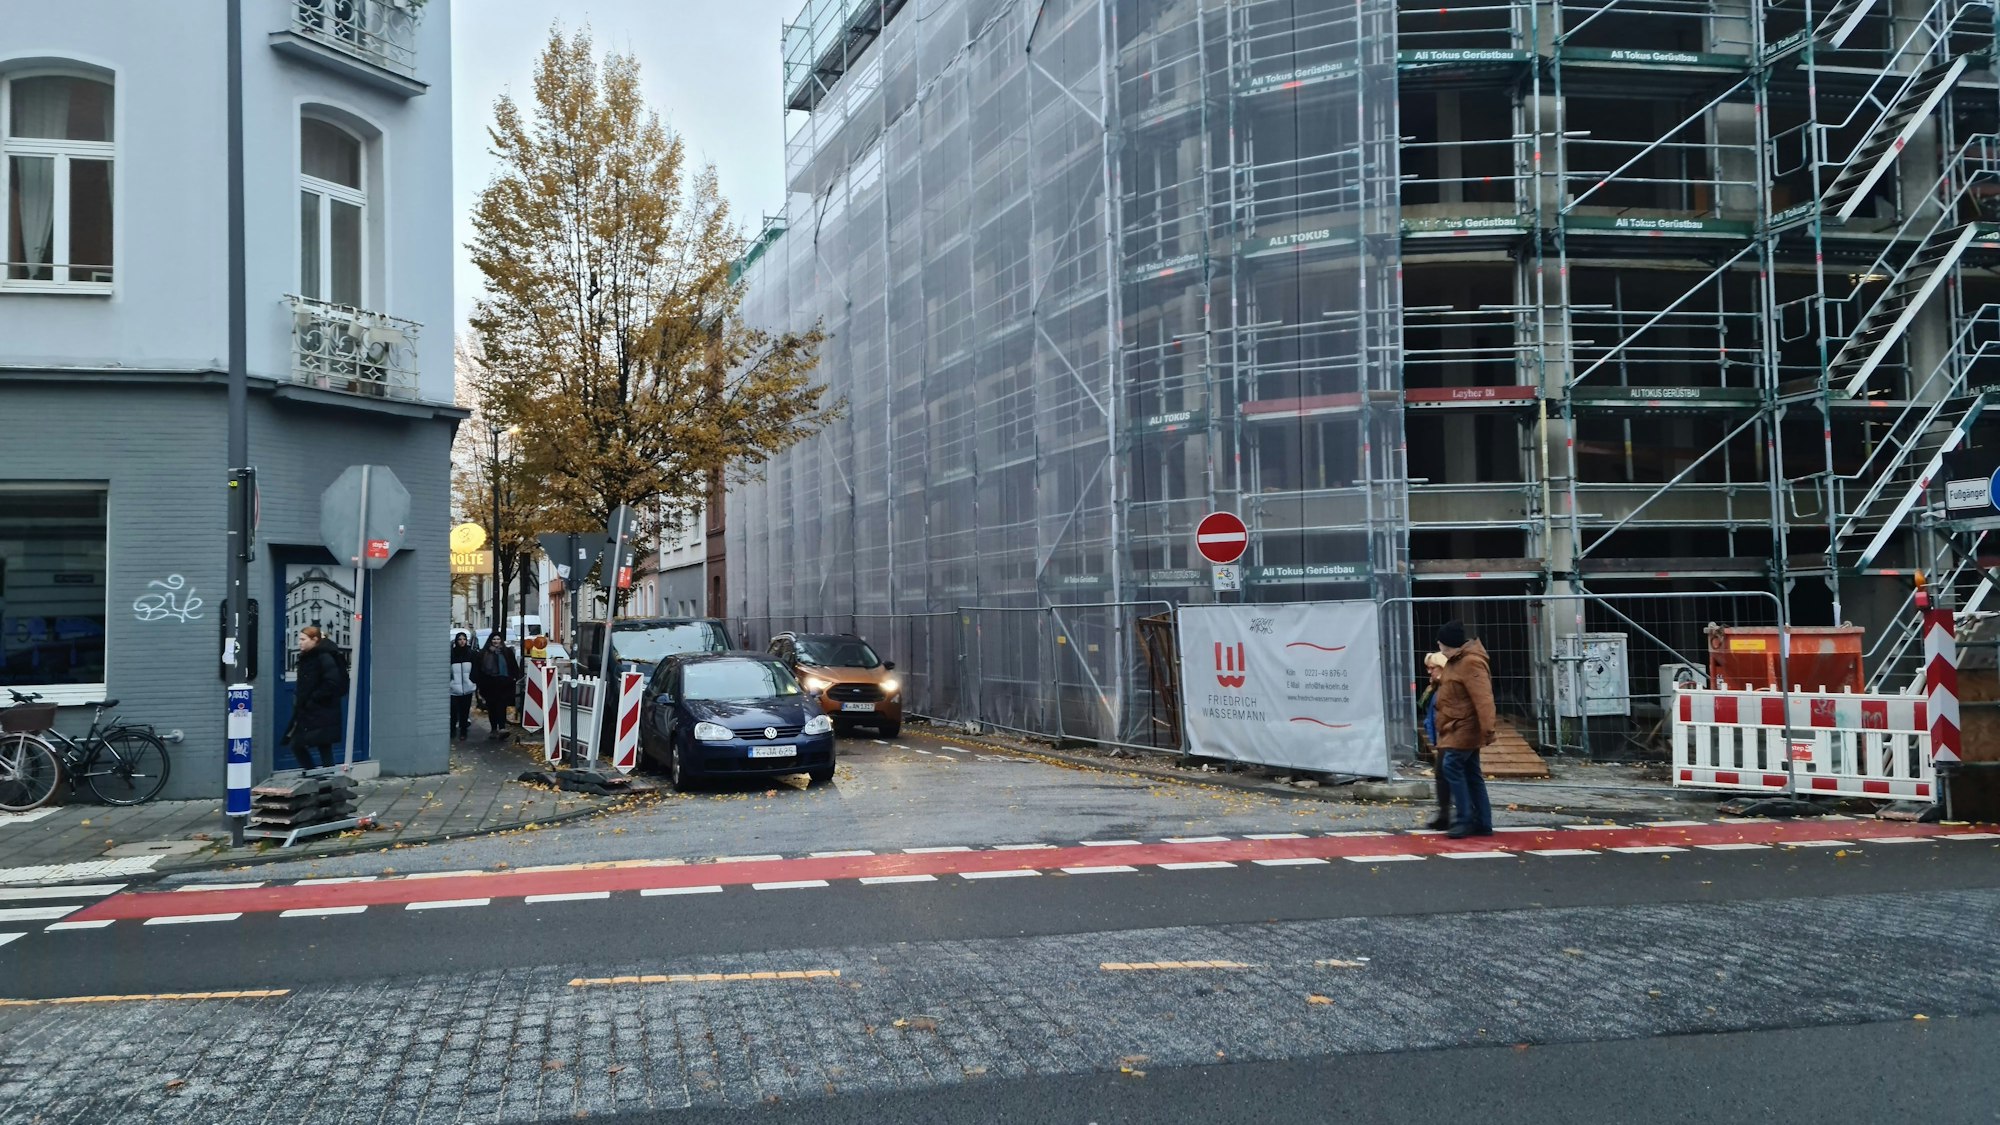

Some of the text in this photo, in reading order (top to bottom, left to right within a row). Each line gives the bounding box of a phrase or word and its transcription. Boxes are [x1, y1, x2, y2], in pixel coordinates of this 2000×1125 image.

[1414, 50, 1514, 60] Ali Tokus Gerüstbau
[1611, 50, 1698, 62] Ali Tokus Gerüstbau
[1251, 62, 1343, 87] Ali Tokus Gerüstbau
[1464, 217, 1517, 227] Gerüstbau
[1615, 218, 1703, 229] Ali Tokus Gerüstbau
[1269, 229, 1330, 246] ALI TOKUS
[1452, 389, 1482, 399] Layher
[1640, 388, 1662, 398] TOKUS
[1149, 411, 1191, 426] ALI TOKUS
[1949, 489, 1986, 501] Fußgänger
[457, 565, 475, 573] BIER
[1262, 565, 1355, 576] Ali Tokus Gerüstbau
[1208, 694, 1257, 708] FRIEDRICH
[1202, 707, 1266, 722] WASSERMANN
